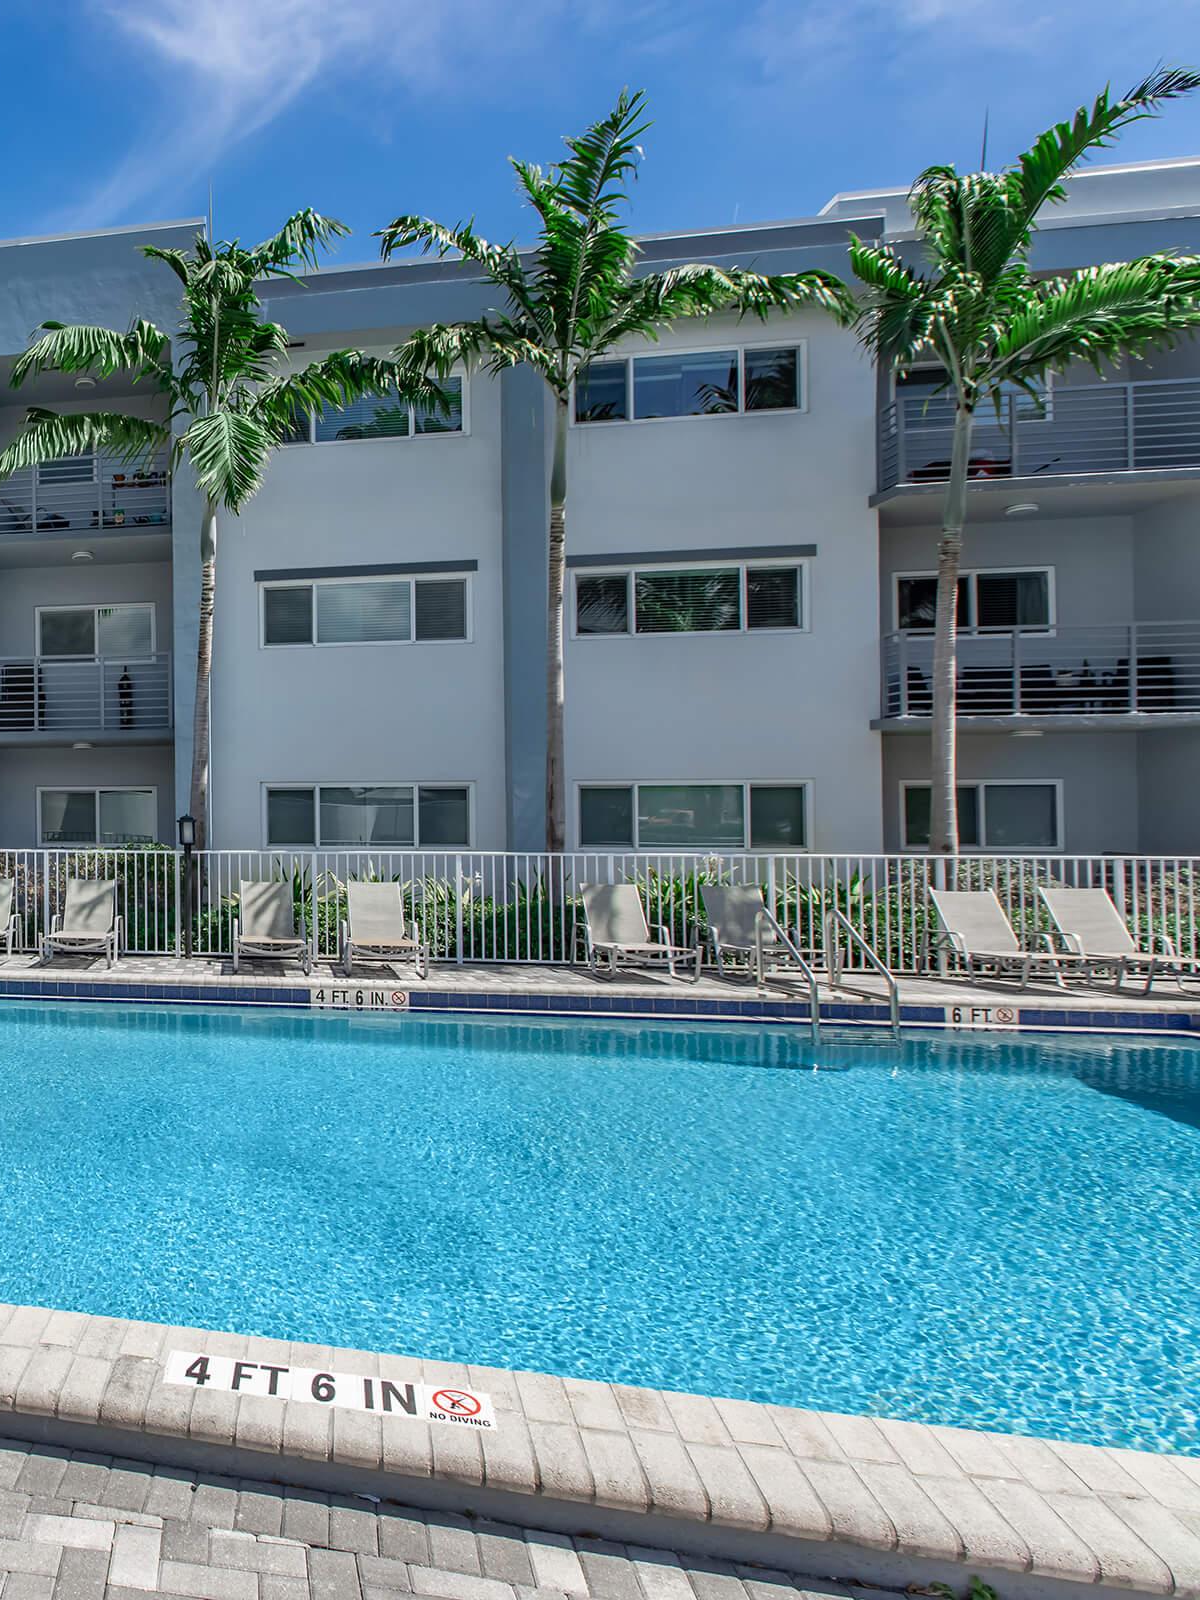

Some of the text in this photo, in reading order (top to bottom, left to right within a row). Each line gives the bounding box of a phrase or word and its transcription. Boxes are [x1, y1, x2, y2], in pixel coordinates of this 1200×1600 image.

[316, 989, 389, 1006] 4 FT. 6 IN.
[952, 1007, 962, 1023] 6
[185, 1356, 418, 1416] 4 FT 6 IN
[429, 1411, 492, 1428] NO DIVING
